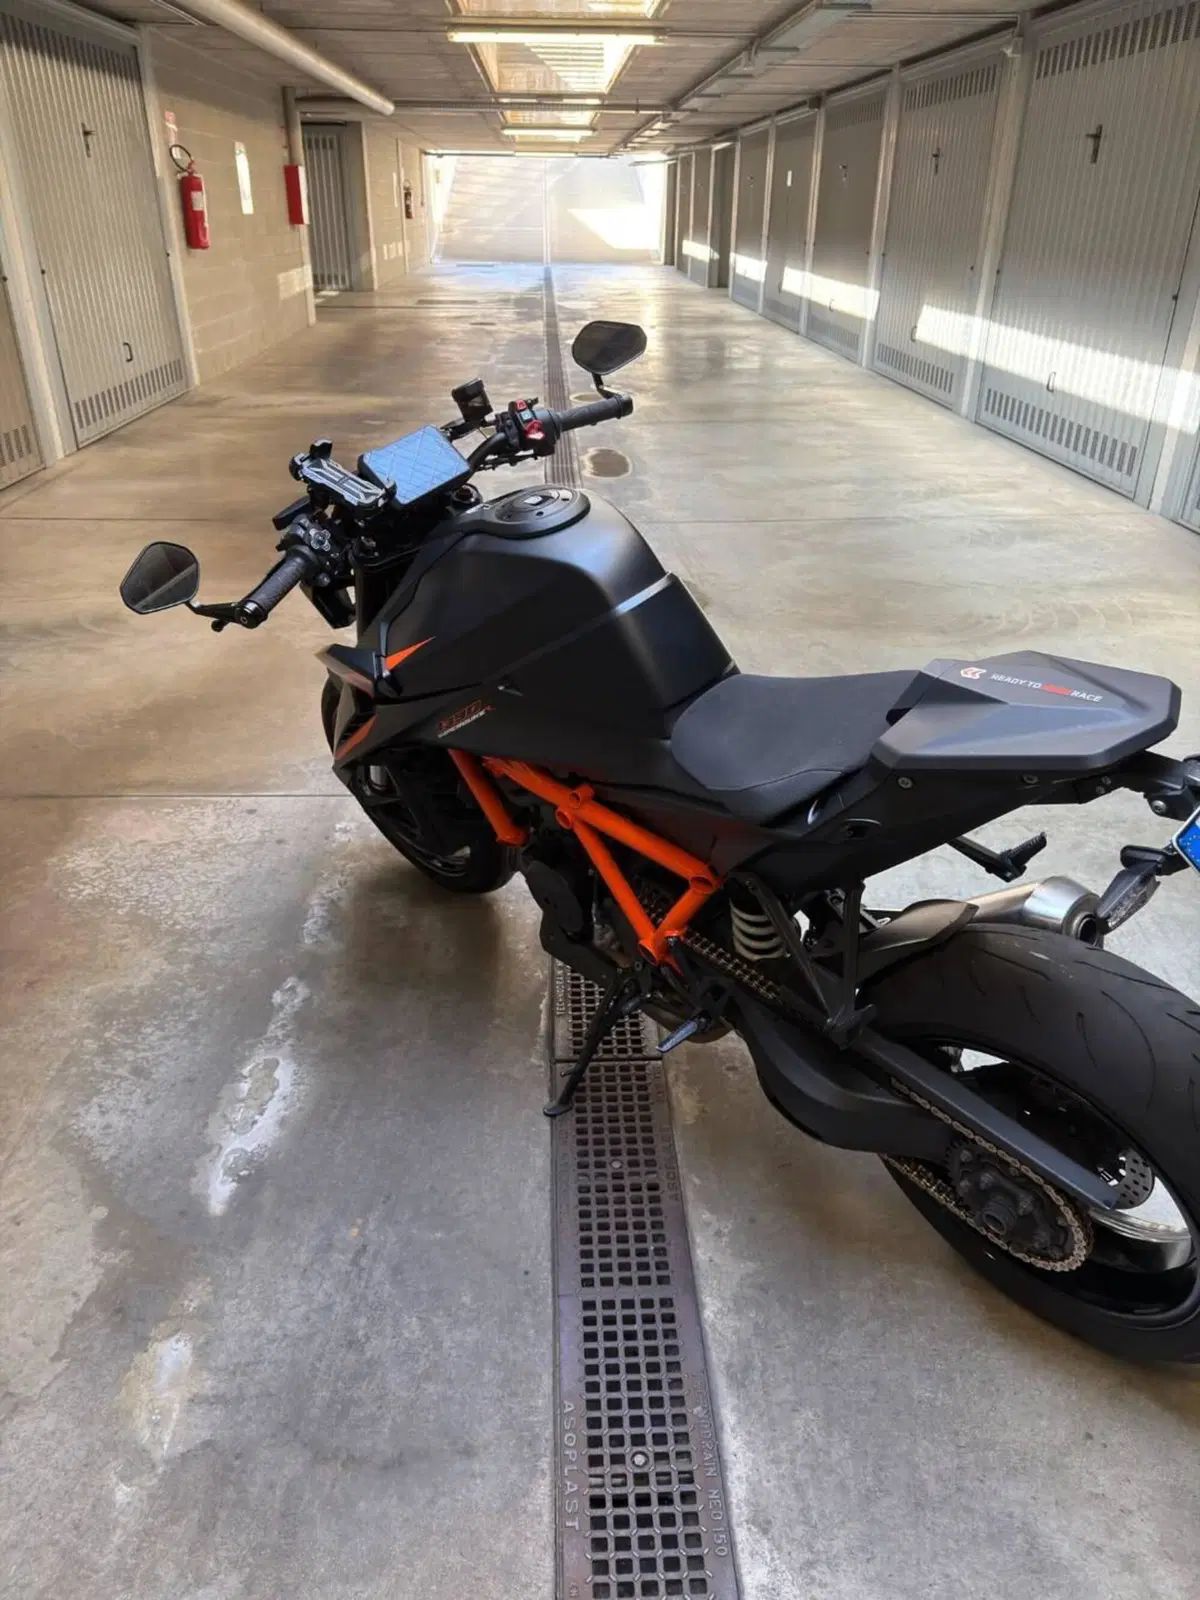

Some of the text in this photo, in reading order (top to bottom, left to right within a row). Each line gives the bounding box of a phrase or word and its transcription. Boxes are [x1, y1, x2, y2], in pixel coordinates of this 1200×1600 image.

[988, 673, 1026, 686] READY
[1070, 690, 1103, 703] RACE
[563, 1400, 580, 1531] ASOPLAST
[708, 1489, 723, 1521] NEO
[712, 1527, 728, 1557] 150
